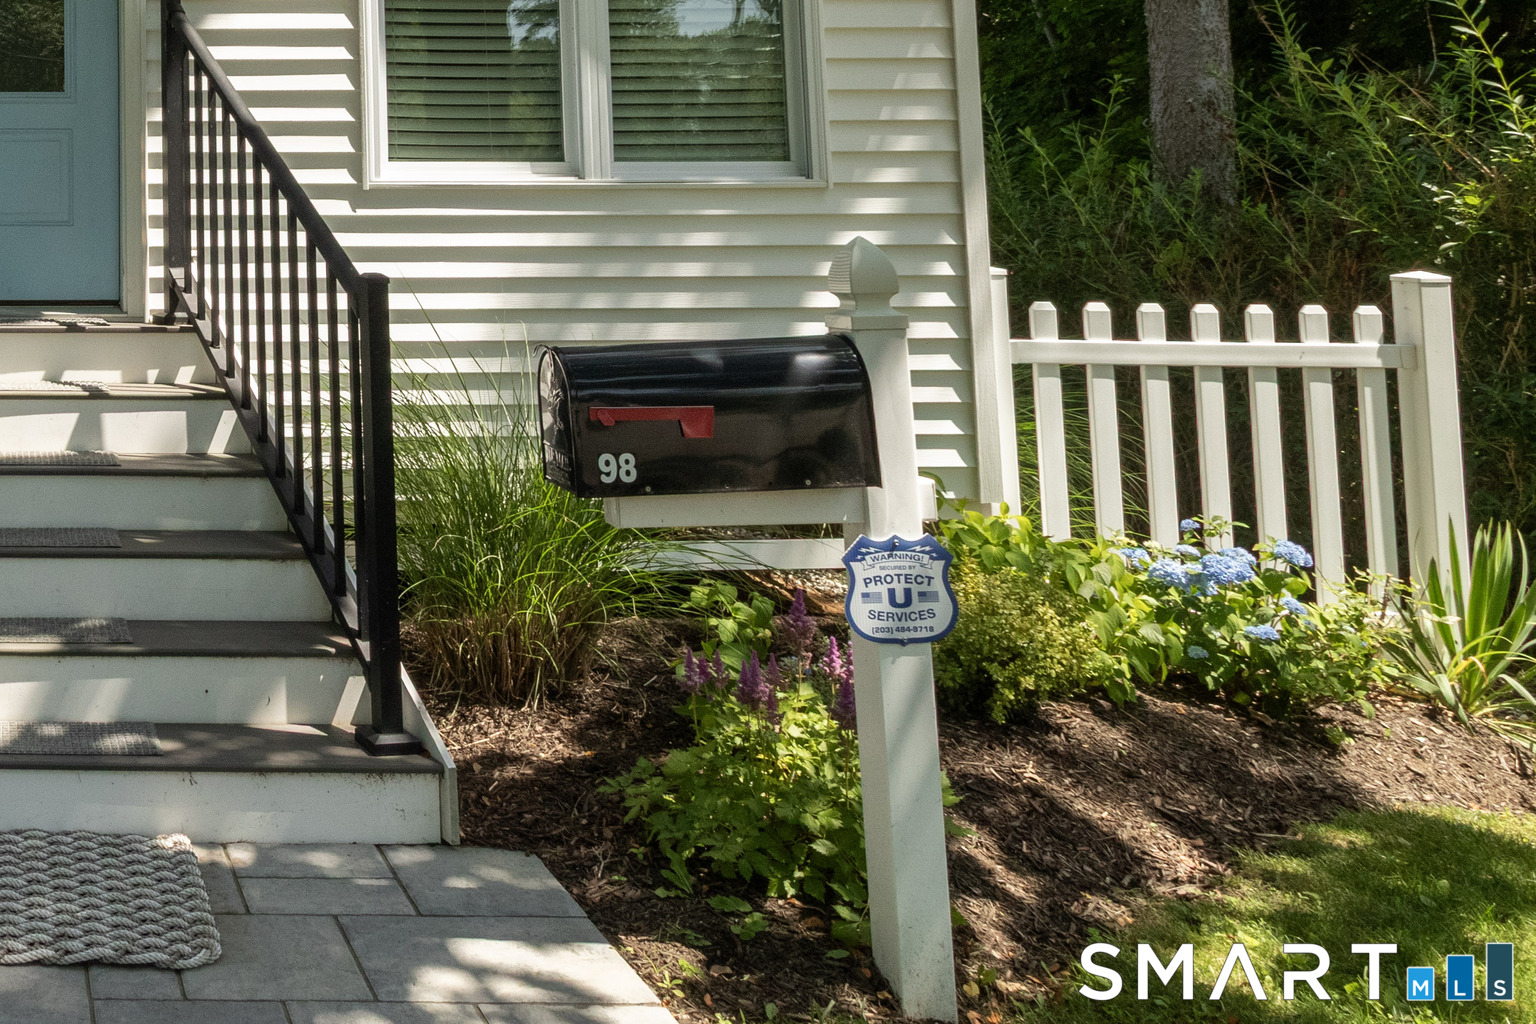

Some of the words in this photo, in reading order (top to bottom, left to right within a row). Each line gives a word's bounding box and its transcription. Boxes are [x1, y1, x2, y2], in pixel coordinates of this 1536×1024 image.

[598, 452, 637, 484] 98
[869, 553, 924, 563] WARNING!
[863, 573, 935, 588] PROTECT
[887, 587, 913, 609] U
[867, 608, 936, 622] SERVICES
[871, 627, 894, 635] (203)
